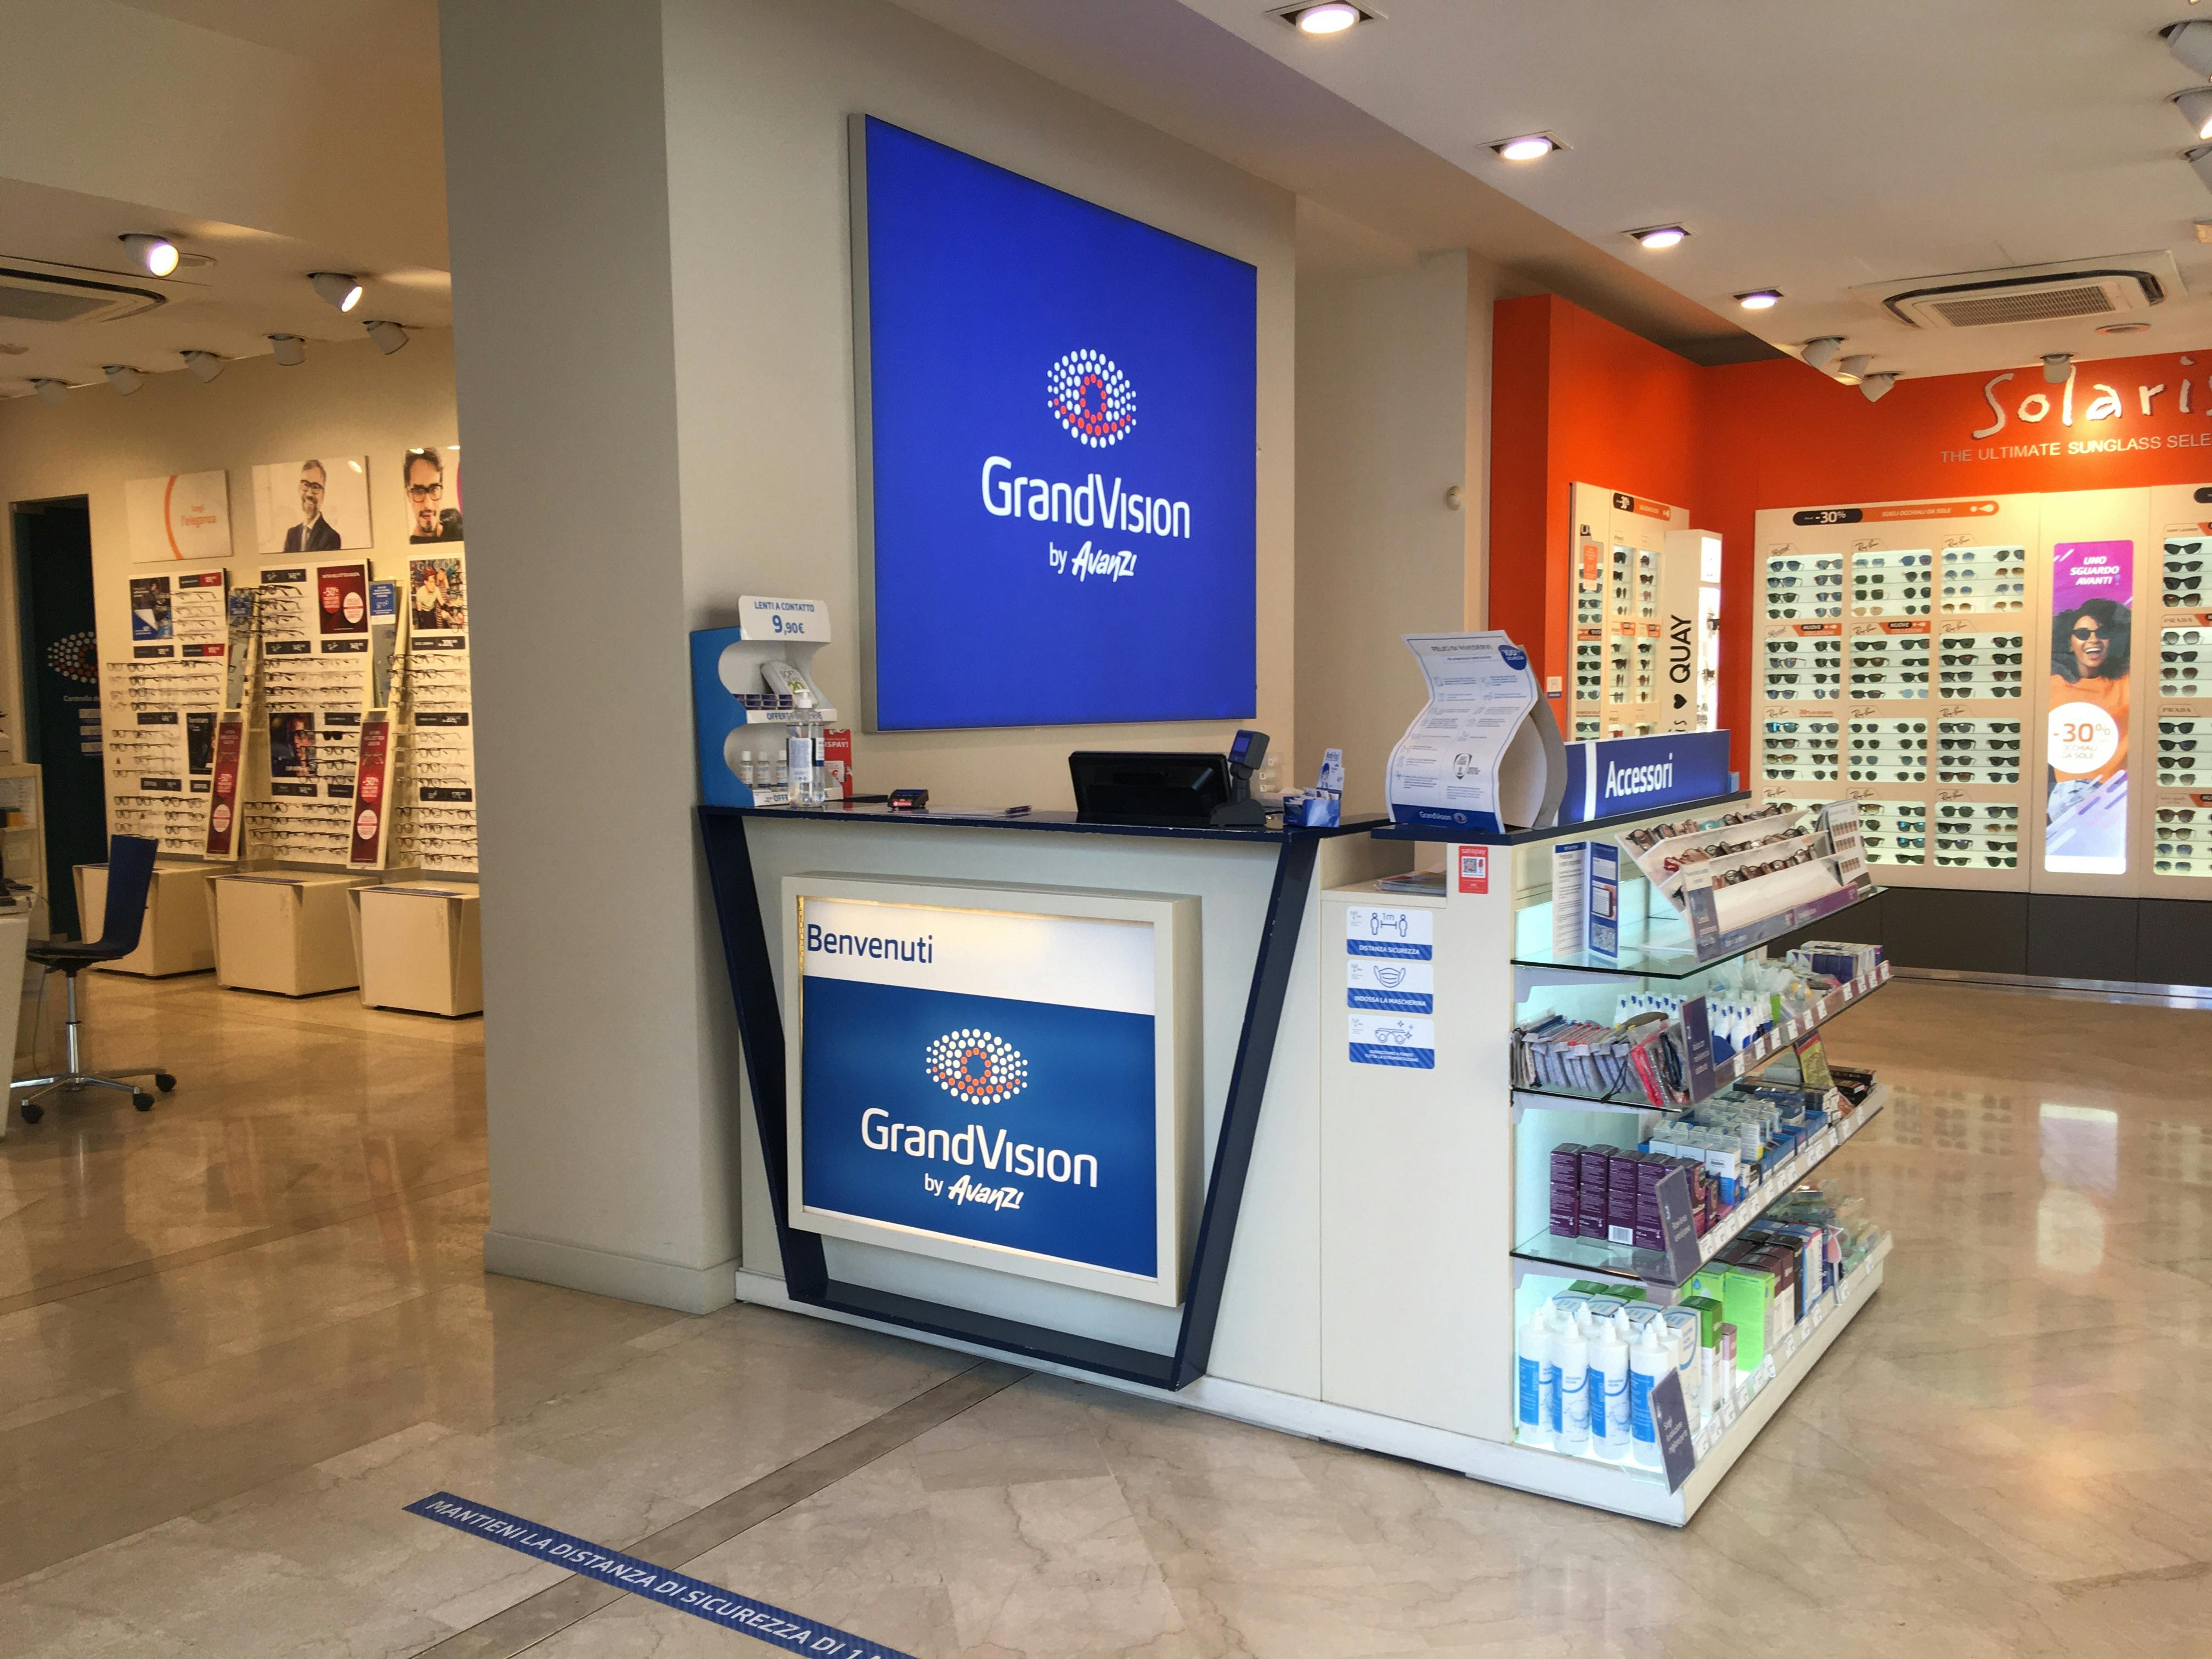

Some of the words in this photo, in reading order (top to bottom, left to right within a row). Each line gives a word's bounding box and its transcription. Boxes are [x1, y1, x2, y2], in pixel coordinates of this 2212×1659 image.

[1940, 449, 1973, 463] THE
[1978, 443, 2061, 461] ULTIMATE
[2067, 435, 2162, 455] SUNGLASS
[982, 456, 1190, 539] GrandVision
[1049, 541, 1068, 574] by
[2069, 566, 2120, 575] SGUARDO
[2083, 556, 2107, 565] UNO
[754, 601, 774, 610] LENTI
[775, 602, 781, 610] A
[781, 602, 815, 612] CONTATTO
[772, 614, 805, 635] 9,90€
[1669, 614, 1691, 684] QUAY
[1605, 752, 1673, 798] Accessori
[1382, 912, 1395, 921] 1m
[808, 923, 933, 964] Benvenuti
[1387, 947, 1421, 955] SICUREZZA
[1389, 998, 1427, 1007] MASCHERINA
[861, 1107, 1098, 1188] GrandVision
[924, 1173, 944, 1197] by
[425, 1500, 527, 1539] MANTIENI
[519, 1533, 552, 1550] LA
[548, 1543, 658, 1588] DISTANZA
[653, 1580, 686, 1597] DI
[680, 1590, 812, 1645] SICUREZZA
[809, 1637, 847, 1655] DI
